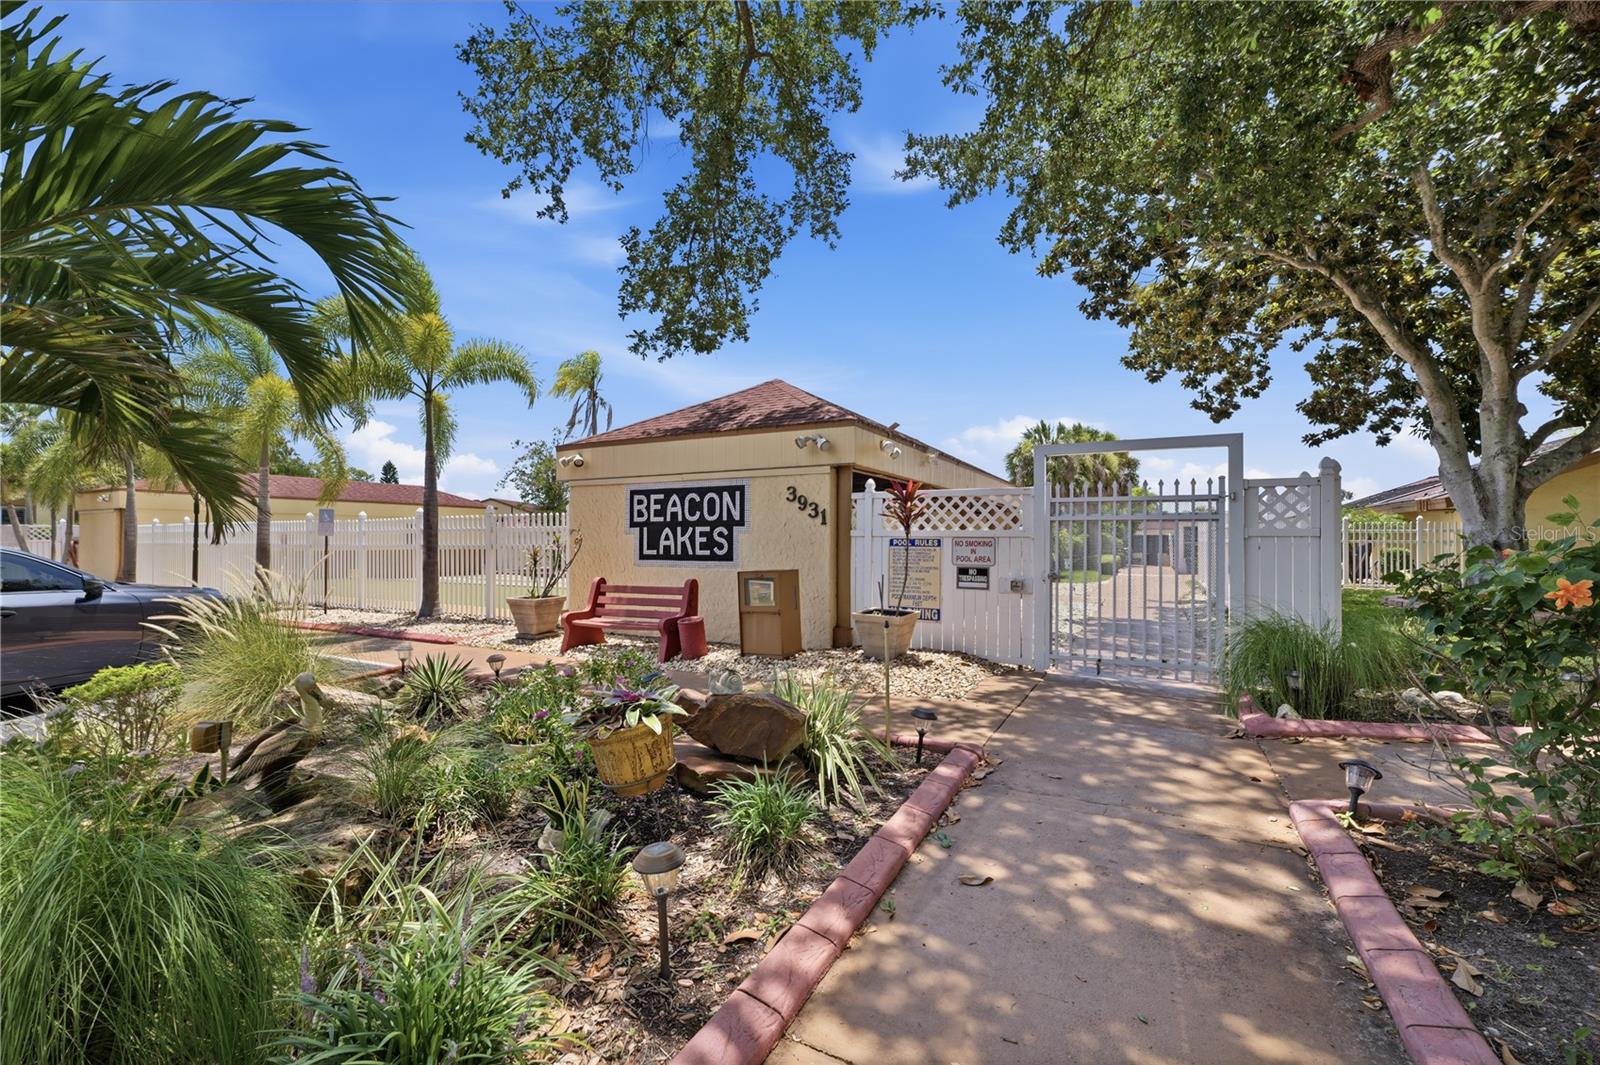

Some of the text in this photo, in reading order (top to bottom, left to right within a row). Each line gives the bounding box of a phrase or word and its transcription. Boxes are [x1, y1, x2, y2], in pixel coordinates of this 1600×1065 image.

[632, 490, 741, 523] BEACON
[786, 485, 828, 526] 3931
[642, 526, 729, 556] LAKES
[915, 539, 938, 547] RULES
[965, 540, 993, 548] SMOKING
[956, 555, 991, 563] POOL AREA
[959, 574, 988, 582] TRESPASSING
